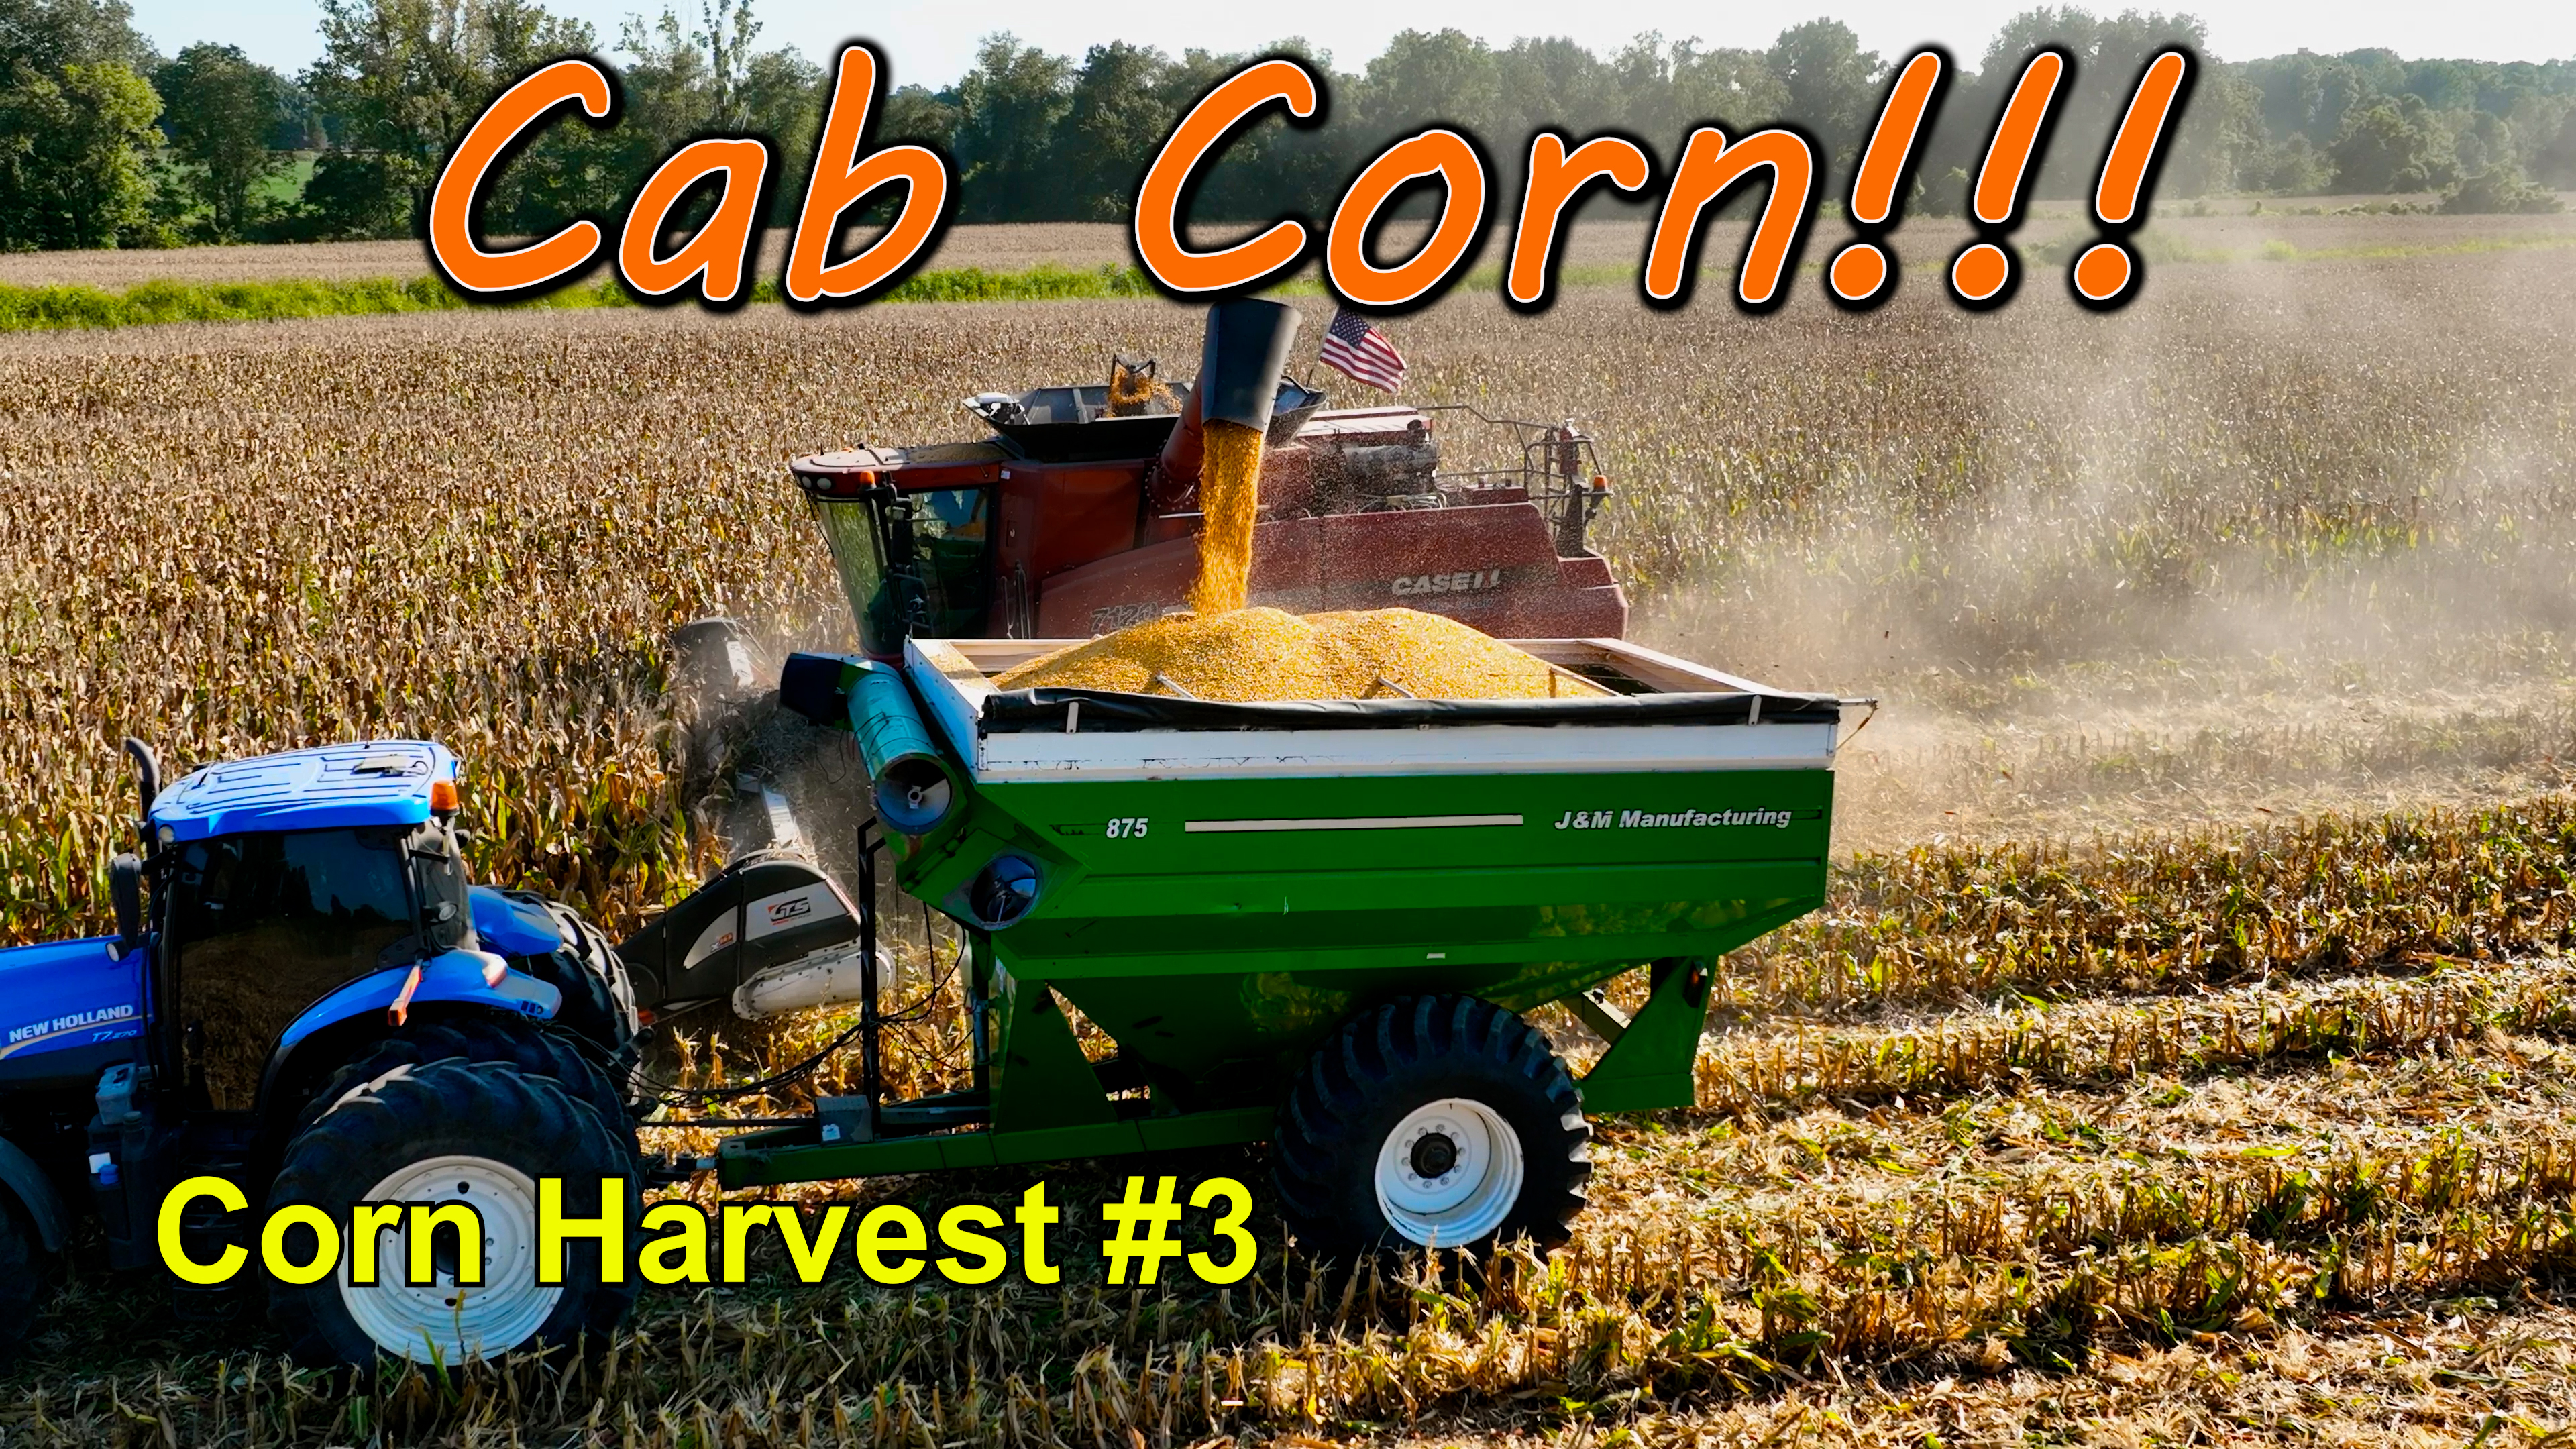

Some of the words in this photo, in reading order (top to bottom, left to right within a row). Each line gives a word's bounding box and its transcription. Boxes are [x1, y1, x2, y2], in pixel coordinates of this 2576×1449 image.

[1391, 572, 1472, 596] CASE
[1091, 602, 1159, 632] 7120
[1106, 817, 1149, 839] 875
[1554, 810, 1613, 830] J&M
[1618, 807, 1792, 829] Manufacturing
[9, 1020, 50, 1043] NEW
[52, 1004, 133, 1032] HOLLAND
